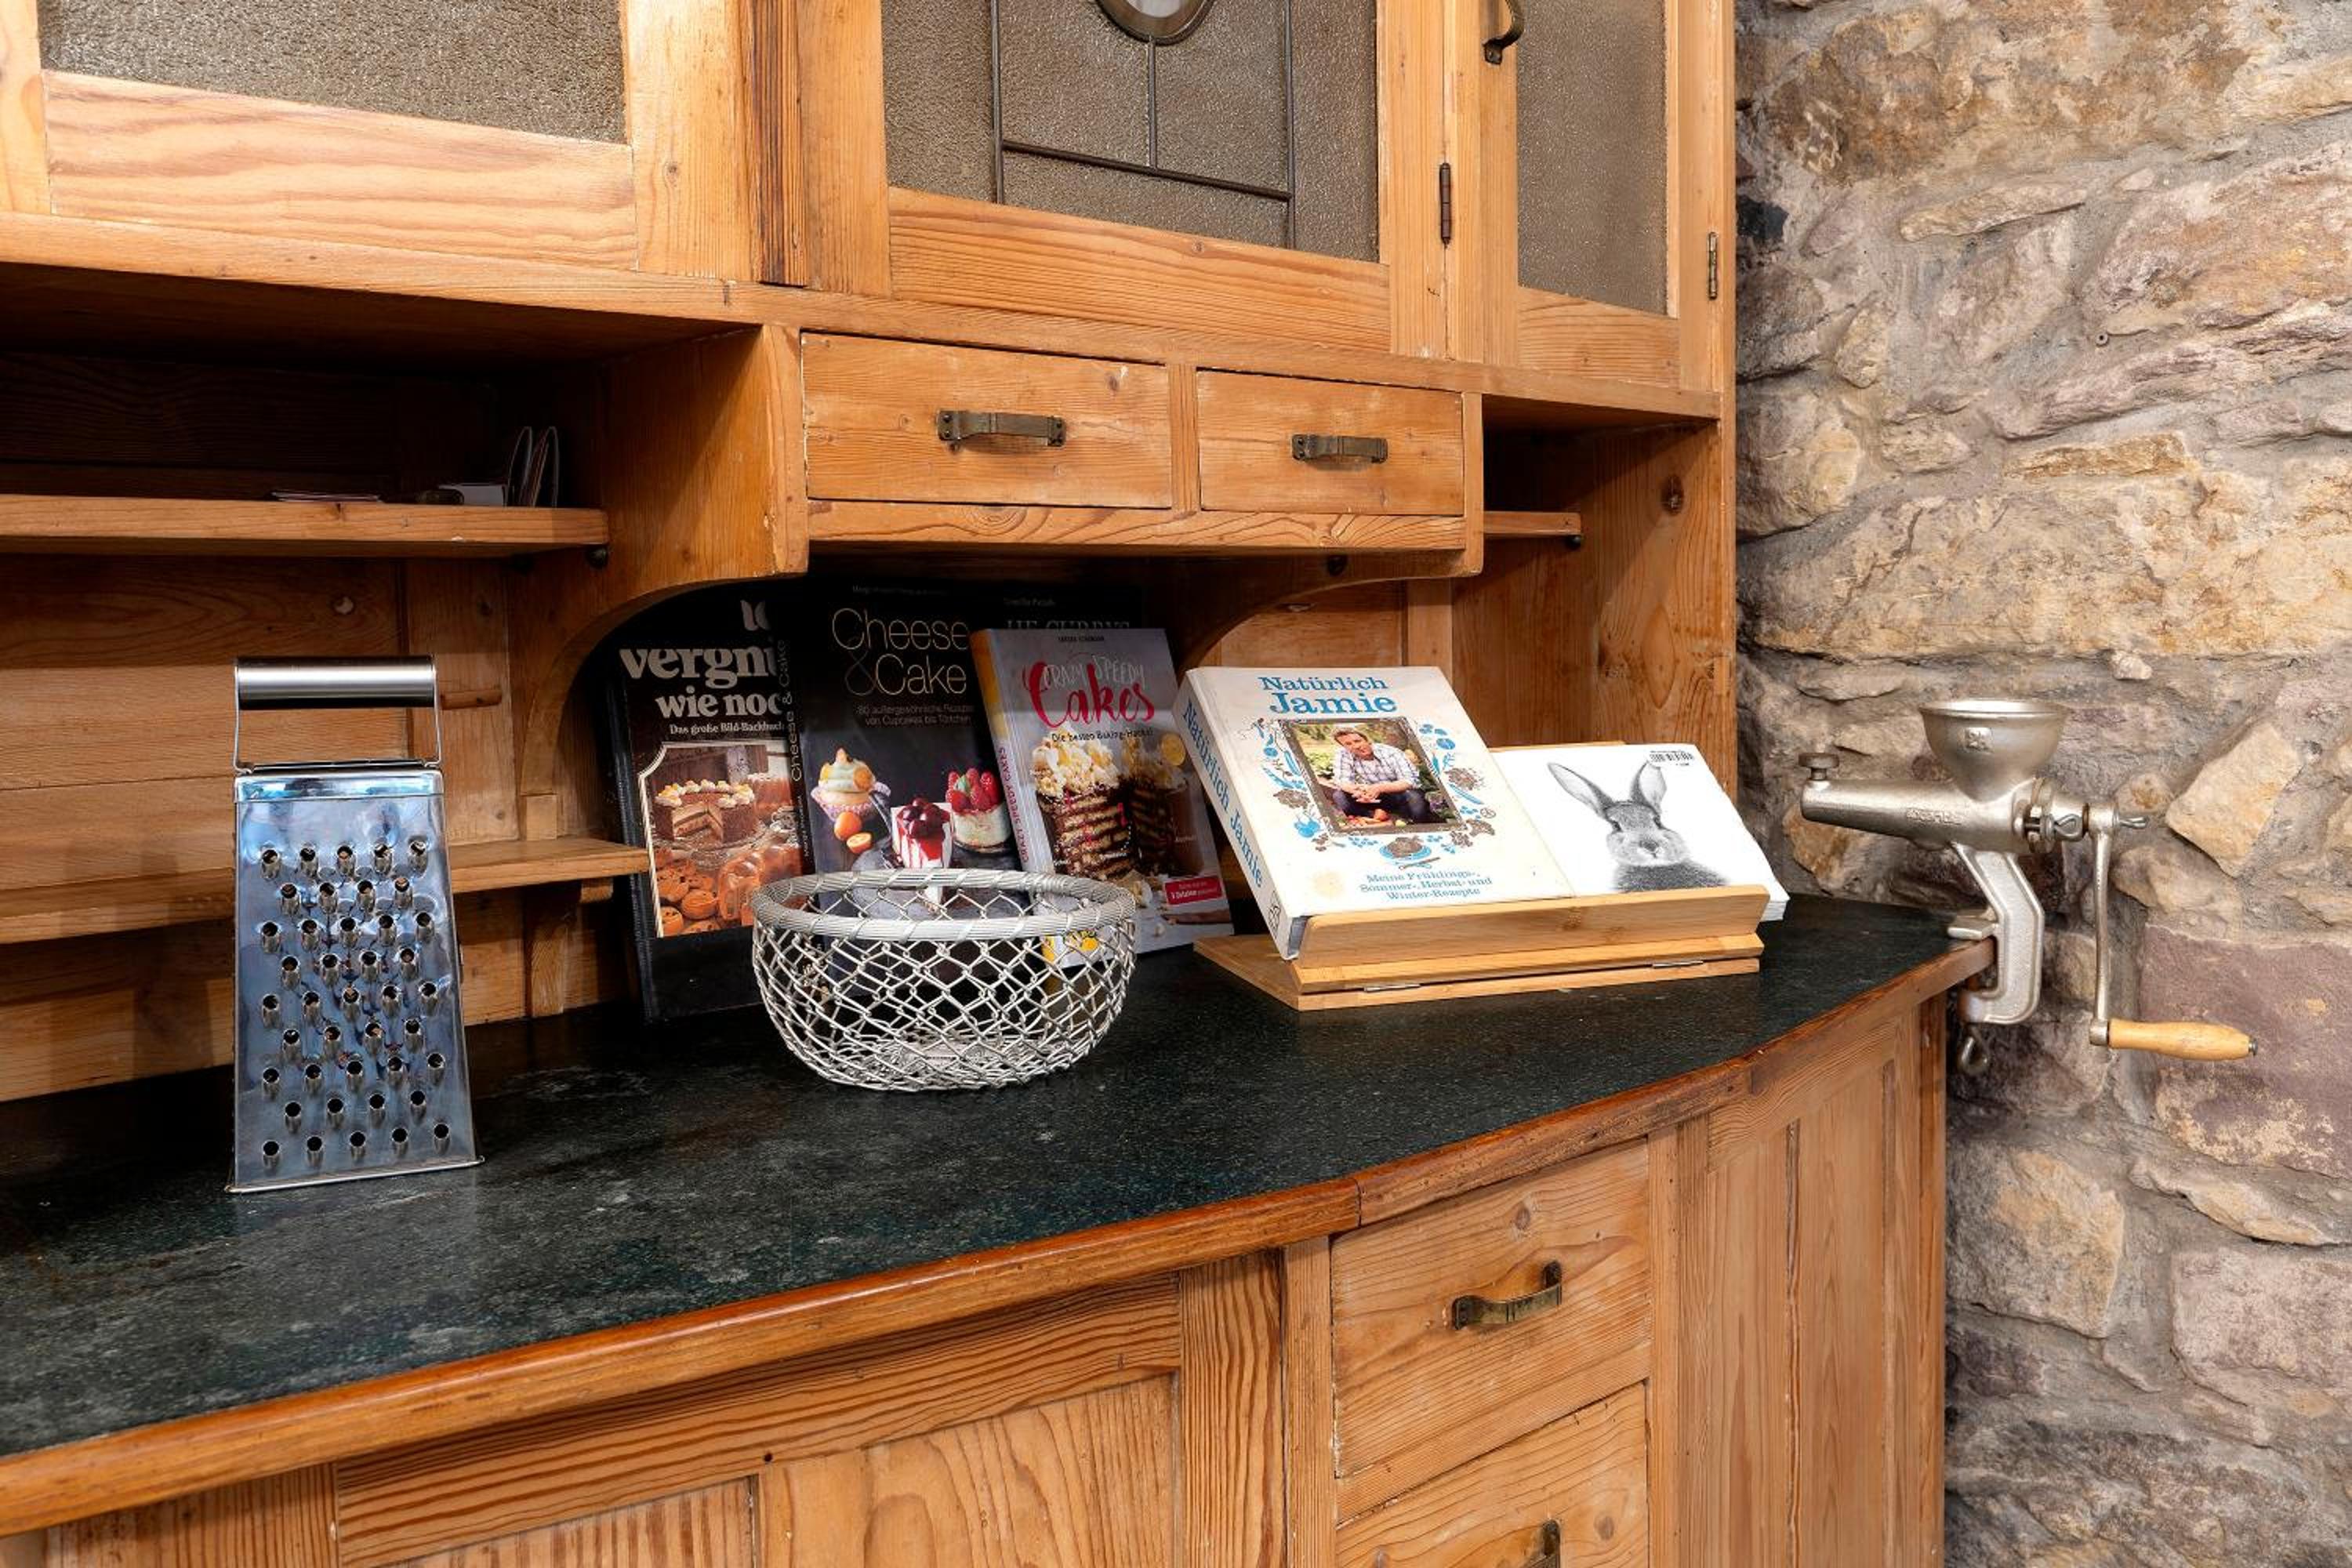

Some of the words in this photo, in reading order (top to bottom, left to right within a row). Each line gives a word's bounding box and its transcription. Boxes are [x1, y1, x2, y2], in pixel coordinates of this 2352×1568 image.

[832, 608, 969, 650] Cheese
[777, 640, 790, 687] Cake
[875, 653, 967, 695] Cake
[782, 691, 793, 705] &
[1029, 660, 1155, 728] Cakes
[1258, 676, 1388, 691] Natürlich
[655, 685, 718, 719] wie
[1269, 691, 1399, 714] Jamie
[670, 724, 688, 735] Das
[690, 724, 719, 735] große
[786, 711, 803, 782] Cheese
[998, 746, 1012, 782] CAKES
[1005, 785, 1022, 824] SPEEDY
[1182, 701, 1229, 814] Natürlich
[1230, 808, 1263, 889] Jamie
[1017, 827, 1029, 863] CRAZY
[1367, 873, 1404, 884] Meine
[1468, 877, 1494, 887] und
